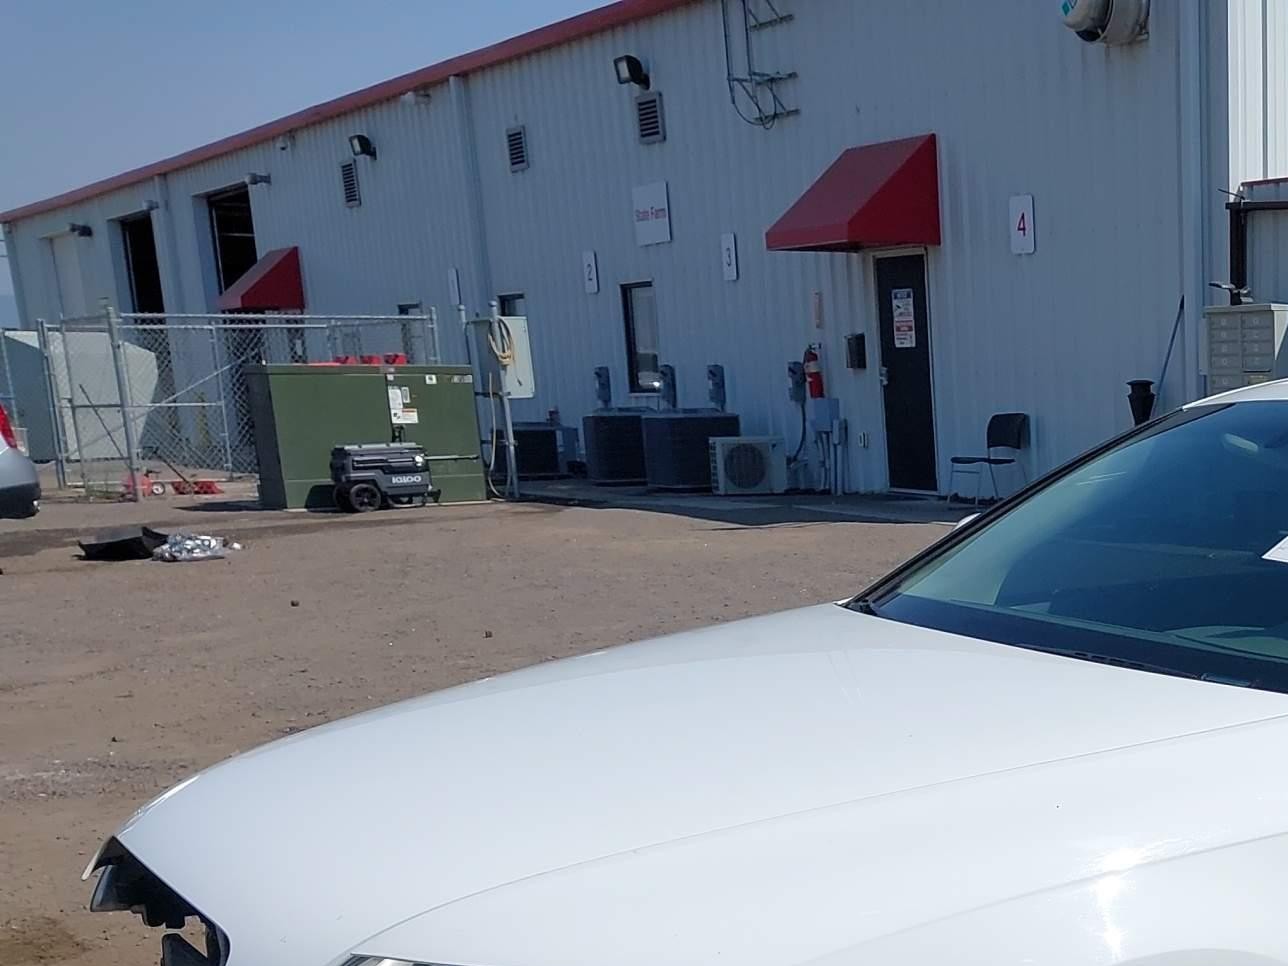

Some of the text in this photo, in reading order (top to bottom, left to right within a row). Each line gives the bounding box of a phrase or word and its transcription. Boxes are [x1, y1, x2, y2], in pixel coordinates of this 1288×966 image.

[1017, 211, 1026, 237] 4
[726, 247, 732, 267] 3
[586, 263, 593, 281] 2
